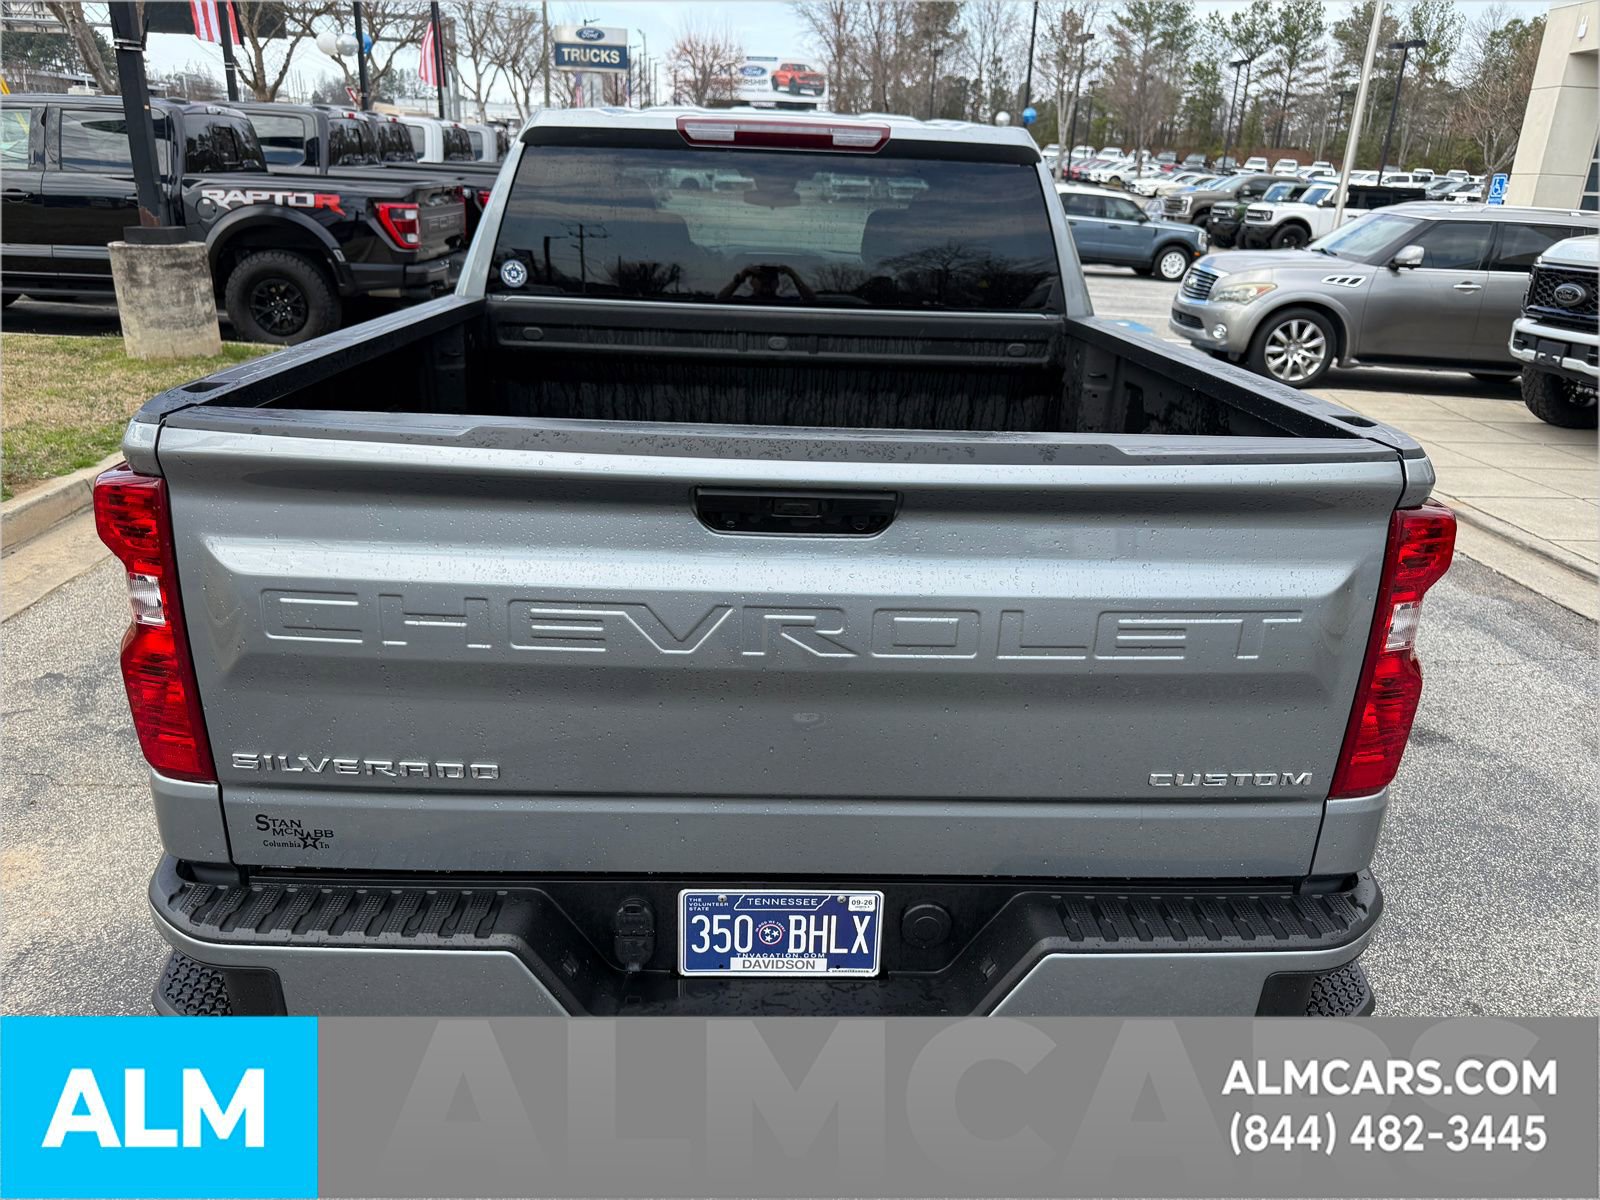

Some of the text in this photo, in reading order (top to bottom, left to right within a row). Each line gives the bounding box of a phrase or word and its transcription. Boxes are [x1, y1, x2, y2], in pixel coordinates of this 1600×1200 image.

[561, 48, 620, 64] TRUCKS
[201, 190, 347, 217] RAPTOR
[260, 588, 1303, 660] CHEVROLET
[231, 753, 500, 780] SILVERADO
[1149, 772, 1313, 787] CUSTOM
[263, 840, 301, 848] Columbia
[747, 898, 818, 906] TENNESSEE
[691, 914, 871, 954] 350 BHLX
[742, 959, 816, 969] DAVIDSON
